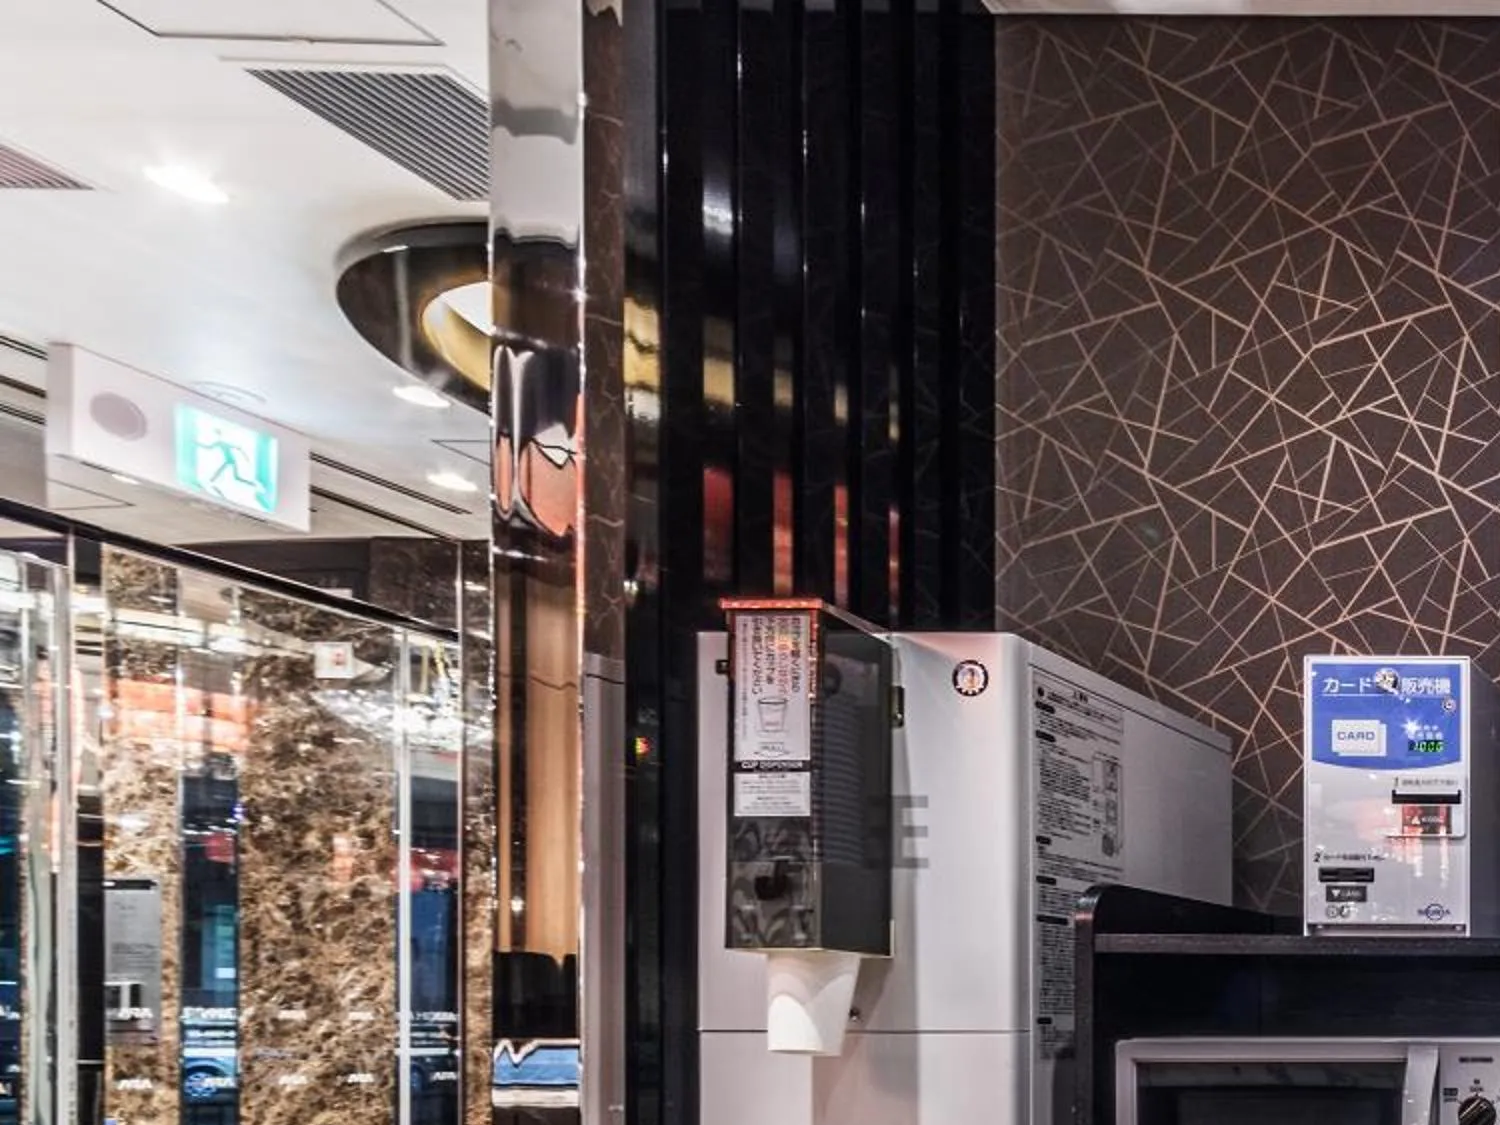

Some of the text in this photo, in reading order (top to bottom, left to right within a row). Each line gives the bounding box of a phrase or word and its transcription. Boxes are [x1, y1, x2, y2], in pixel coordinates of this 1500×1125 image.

[1322, 677, 1451, 694] カード 販売機
[1337, 731, 1376, 741] CARD
[741, 761, 759, 769] CUP
